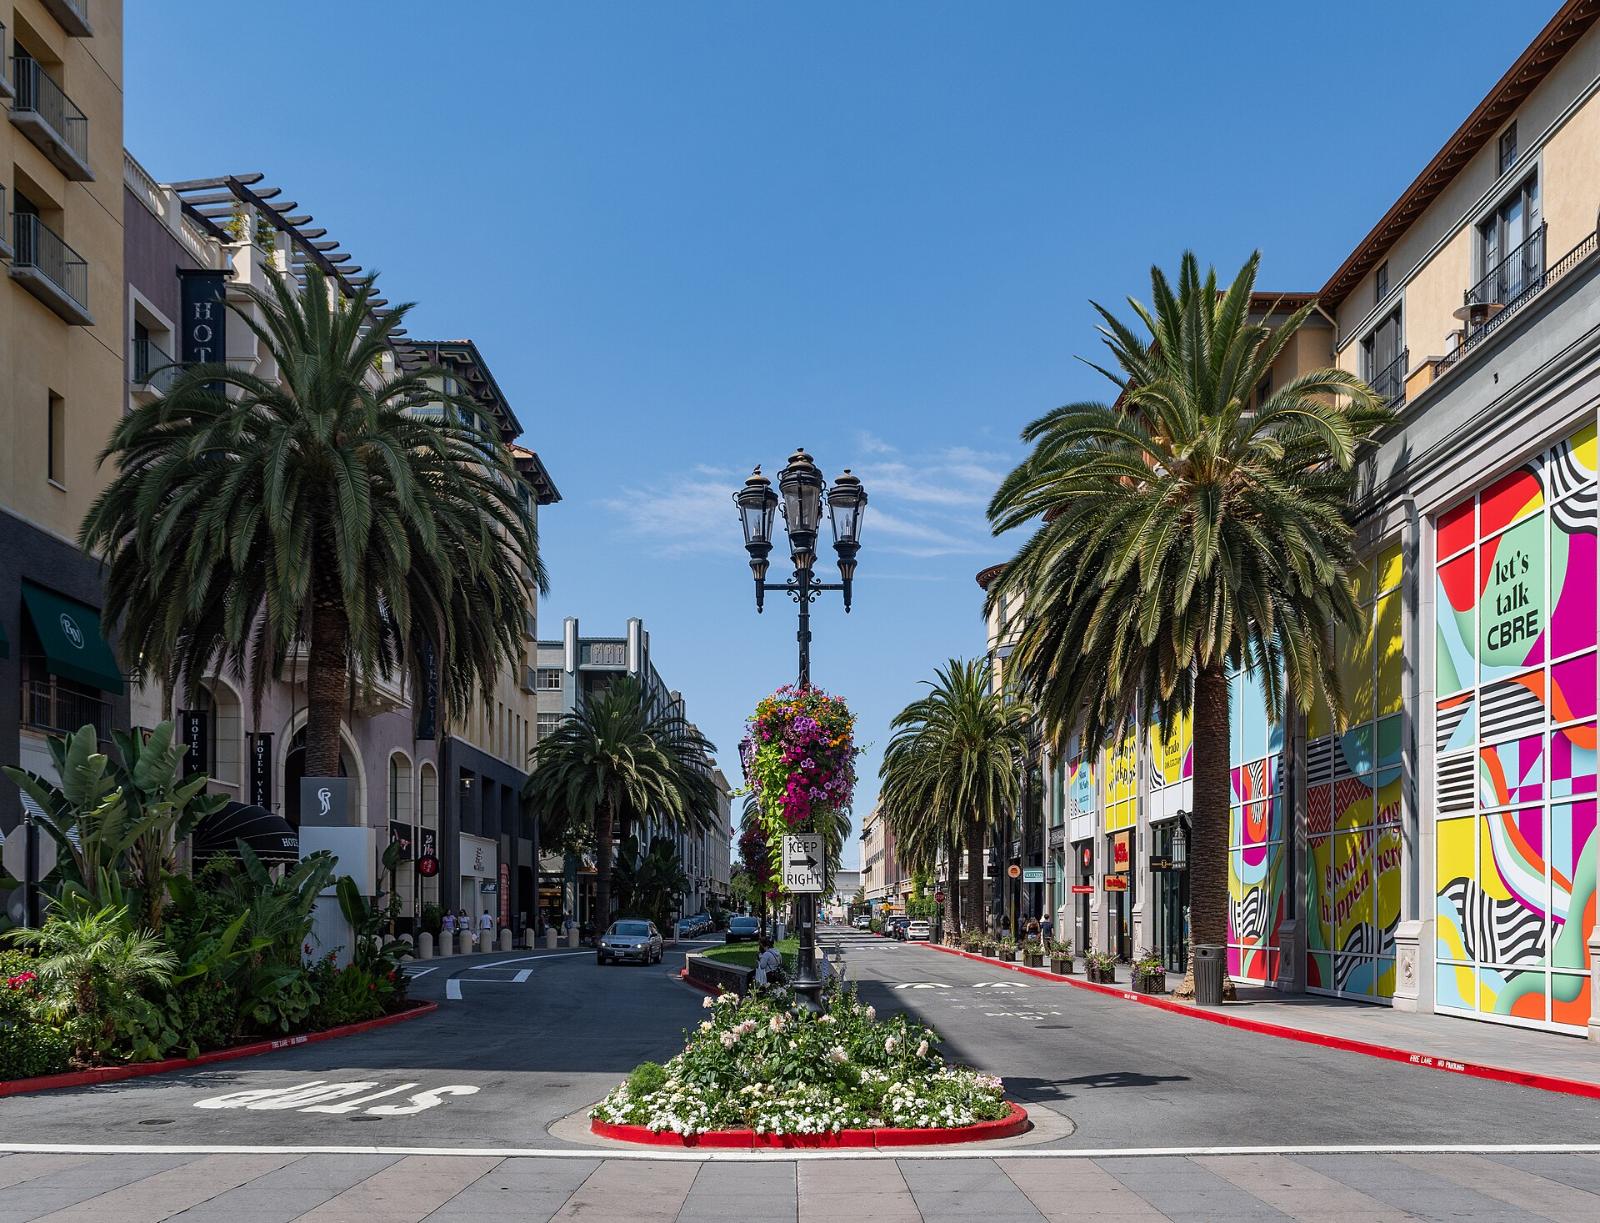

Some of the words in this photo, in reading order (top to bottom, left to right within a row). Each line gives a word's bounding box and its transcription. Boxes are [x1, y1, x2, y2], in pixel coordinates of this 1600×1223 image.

[193, 302, 213, 387] HOT
[1496, 550, 1529, 586] let's
[1496, 581, 1530, 616] talk
[1487, 609, 1539, 651] CBRE
[191, 718, 199, 756] HOTEL
[257, 740, 265, 774] HOTEL
[788, 841, 818, 853] KEEP
[1325, 842, 1358, 894] good
[1361, 800, 1401, 856] thing
[1371, 845, 1401, 876] her
[787, 873, 821, 885] RIGHT
[1410, 1055, 1420, 1063] FIRE
[1421, 1056, 1433, 1065] LANE
[193, 1081, 480, 1114] STOP
